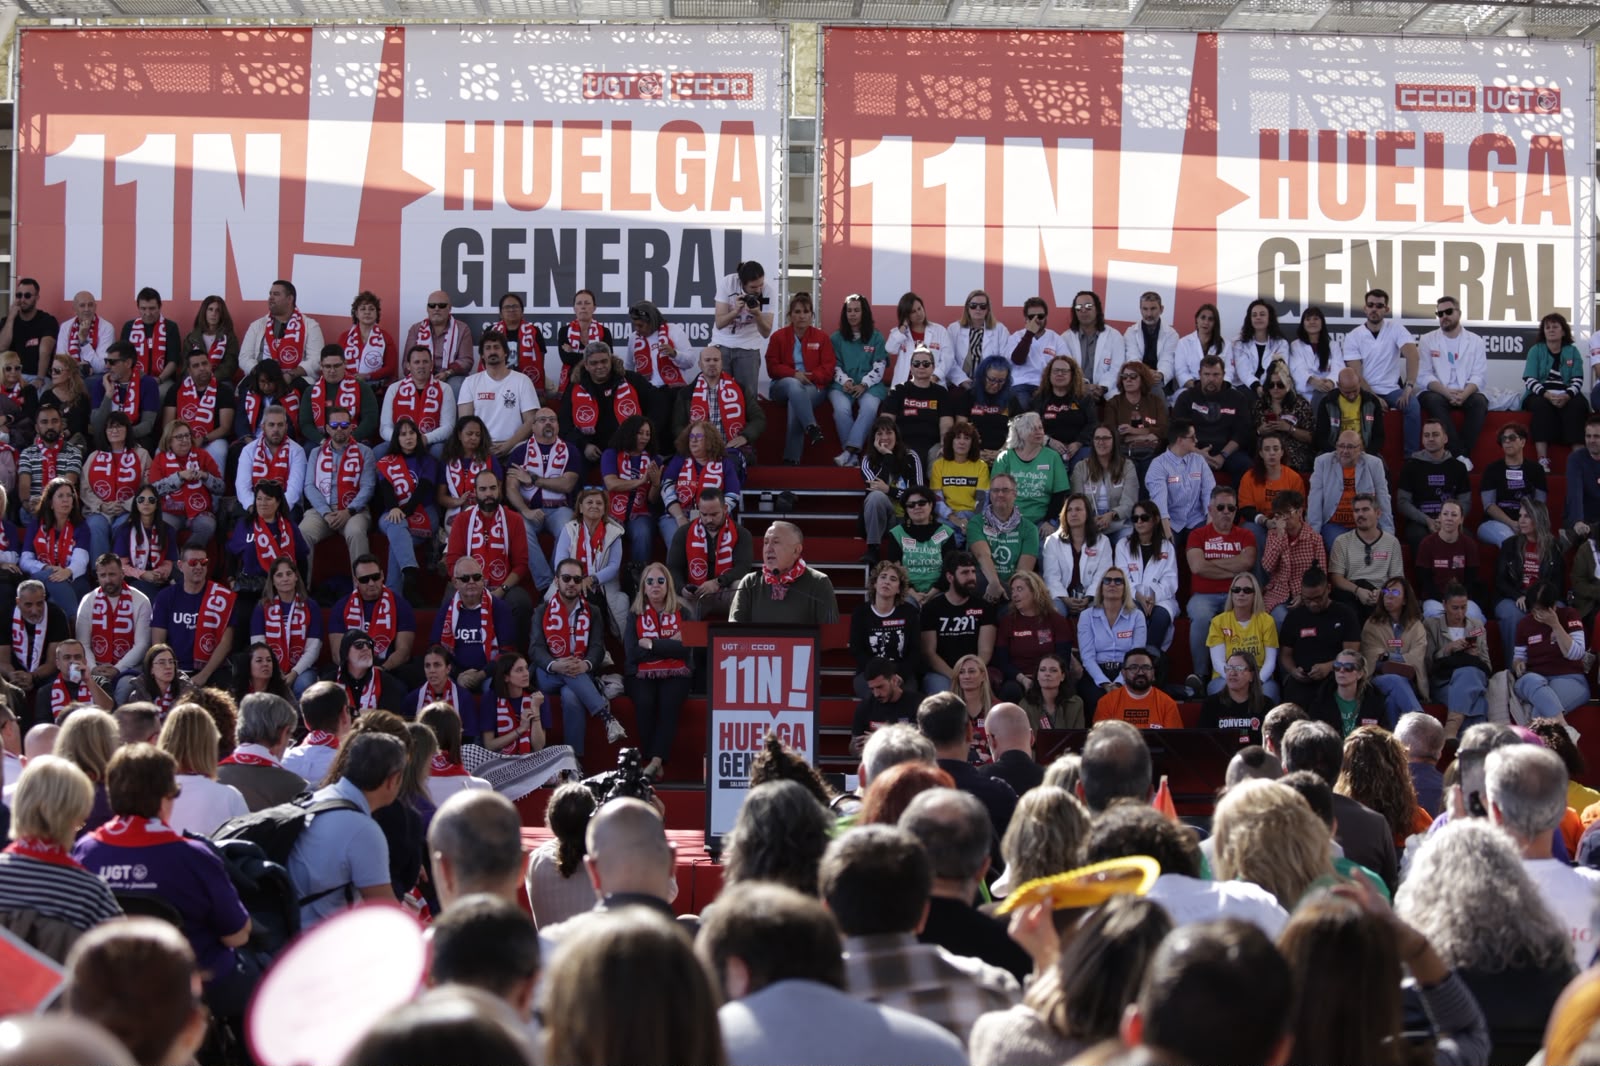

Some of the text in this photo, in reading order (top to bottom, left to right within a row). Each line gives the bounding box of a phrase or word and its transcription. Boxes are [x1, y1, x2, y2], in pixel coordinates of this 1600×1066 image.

[587, 76, 749, 96] UGT CCOO
[1400, 90, 1534, 109] CCOO UGT
[444, 119, 763, 212] HUELGA
[1259, 128, 1571, 225] HUELGA
[1258, 237, 1572, 322] GENERAL
[1484, 335, 1523, 353] ECIOS
[343, 445, 361, 487] UGT
[943, 478, 967, 486] CCOO
[1205, 541, 1233, 551] BASTA
[203, 583, 232, 628] UGT
[174, 613, 199, 624] UGT
[939, 617, 976, 632] 7.291
[721, 643, 738, 651] UGT
[101, 866, 131, 880] UGT
